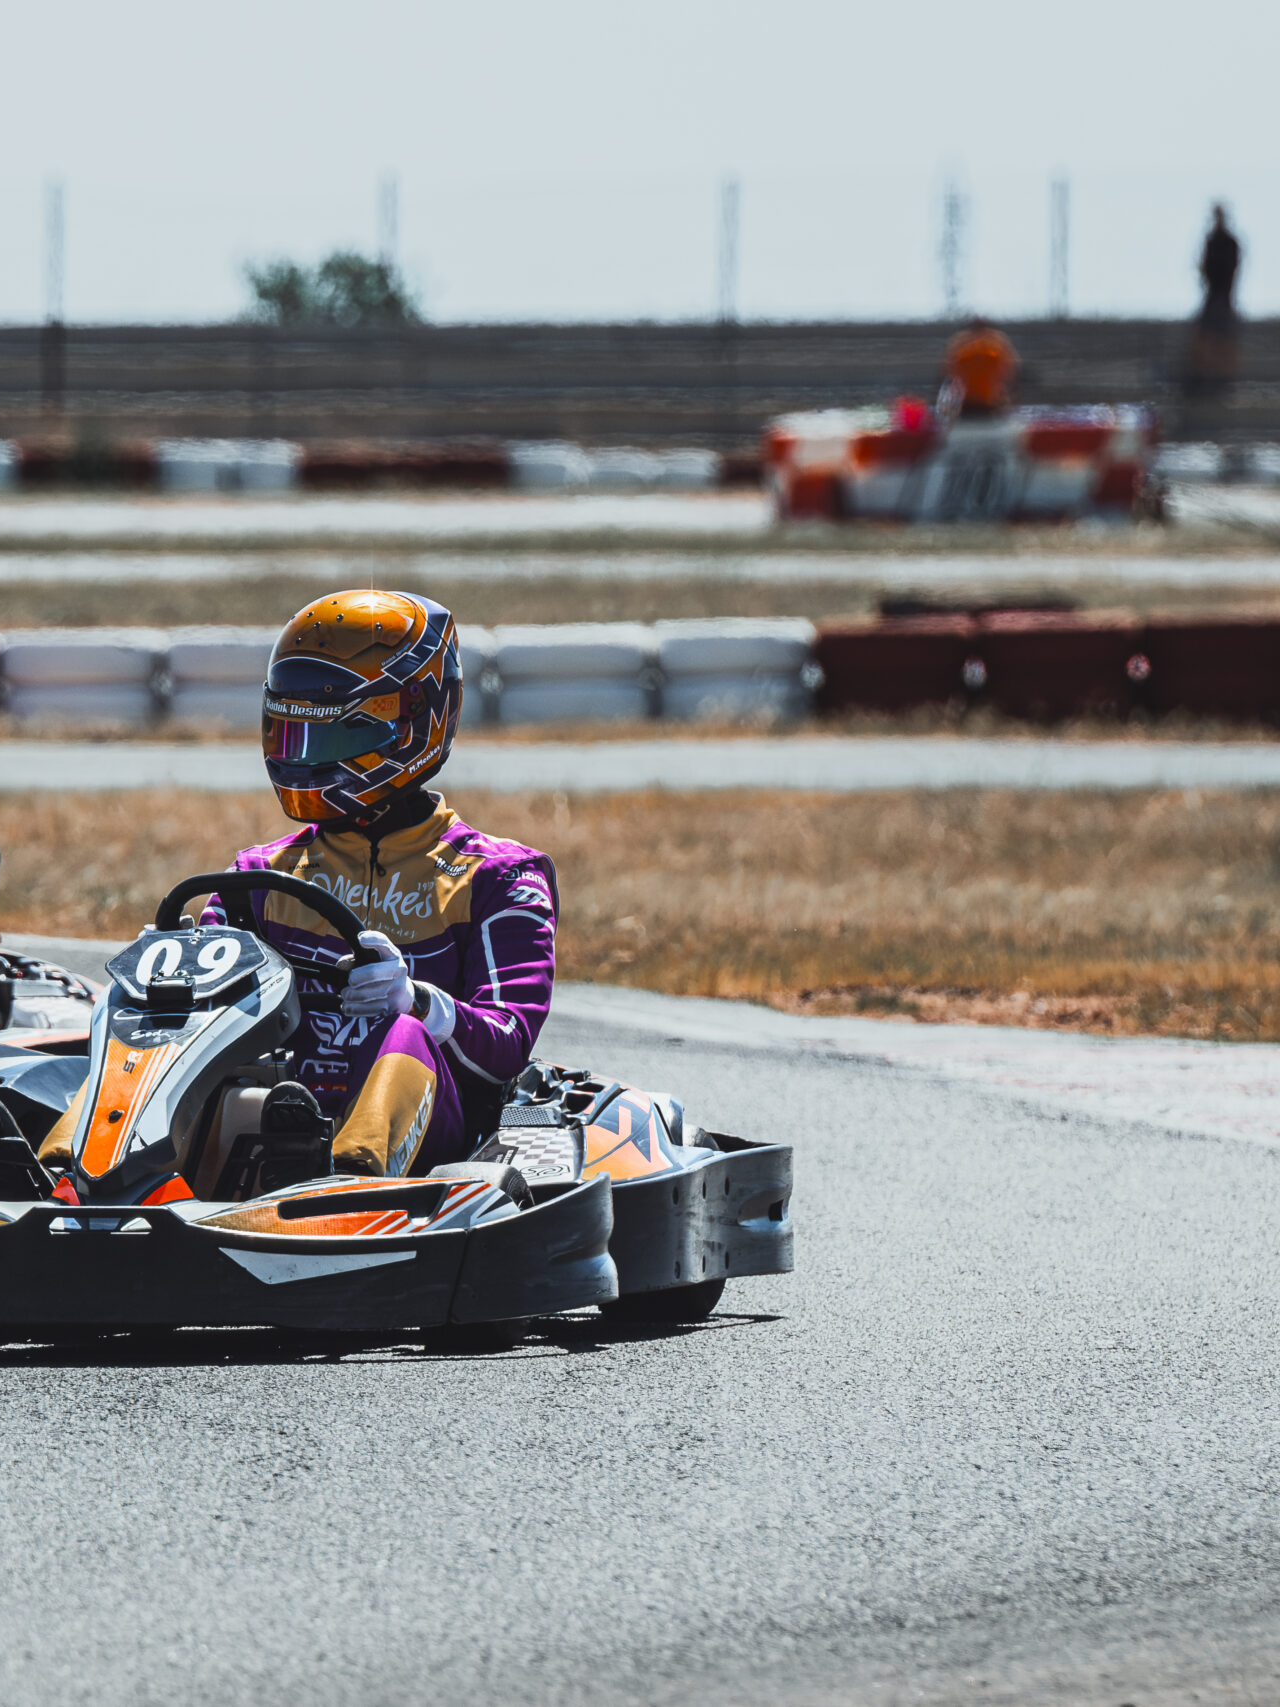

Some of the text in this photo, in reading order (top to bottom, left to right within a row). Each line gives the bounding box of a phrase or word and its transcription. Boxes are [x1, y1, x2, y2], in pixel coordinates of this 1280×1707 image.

[266, 698, 343, 718] Radok Designs
[135, 937, 242, 987] 09
